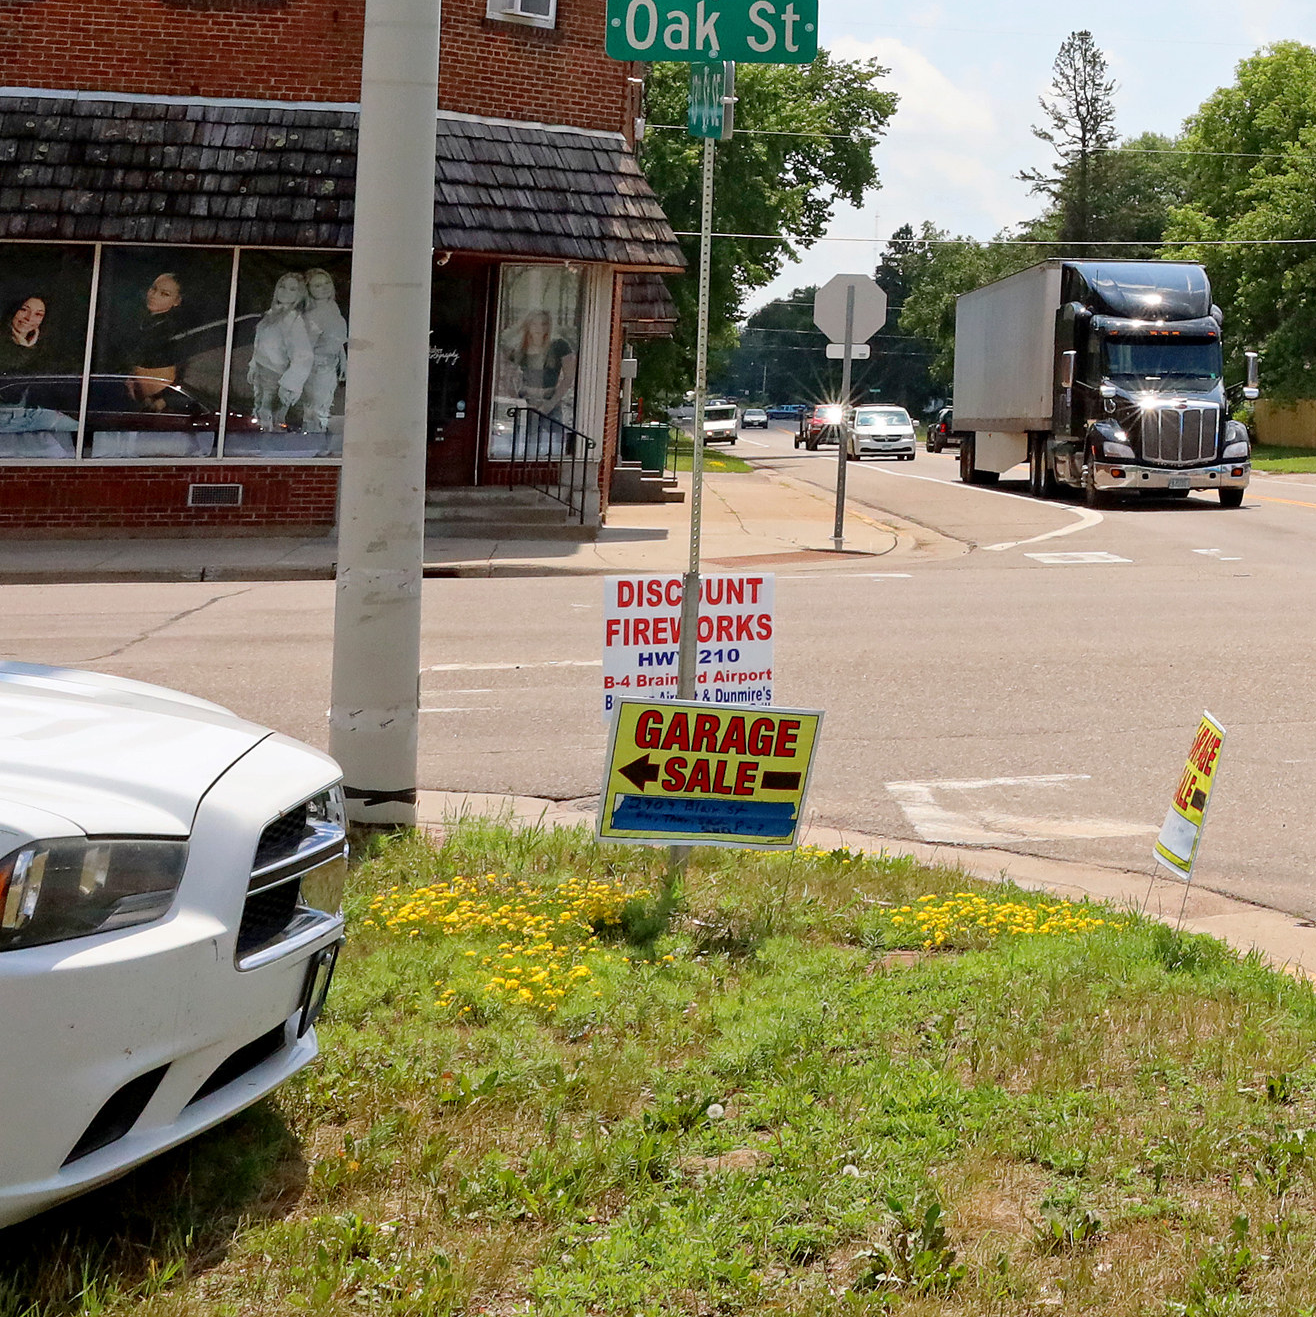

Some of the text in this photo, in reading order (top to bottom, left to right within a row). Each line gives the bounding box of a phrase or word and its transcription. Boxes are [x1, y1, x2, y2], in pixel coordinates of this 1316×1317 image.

[746, 0, 800, 53] St
[617, 578, 764, 608] DISCUNT
[638, 648, 741, 667] HW 210
[603, 668, 773, 690] B-4 Braind Airport
[702, 688, 711, 702] &
[715, 686, 772, 703] Dunmire's
[634, 710, 801, 758] GARAGE
[661, 756, 760, 796] SALE
